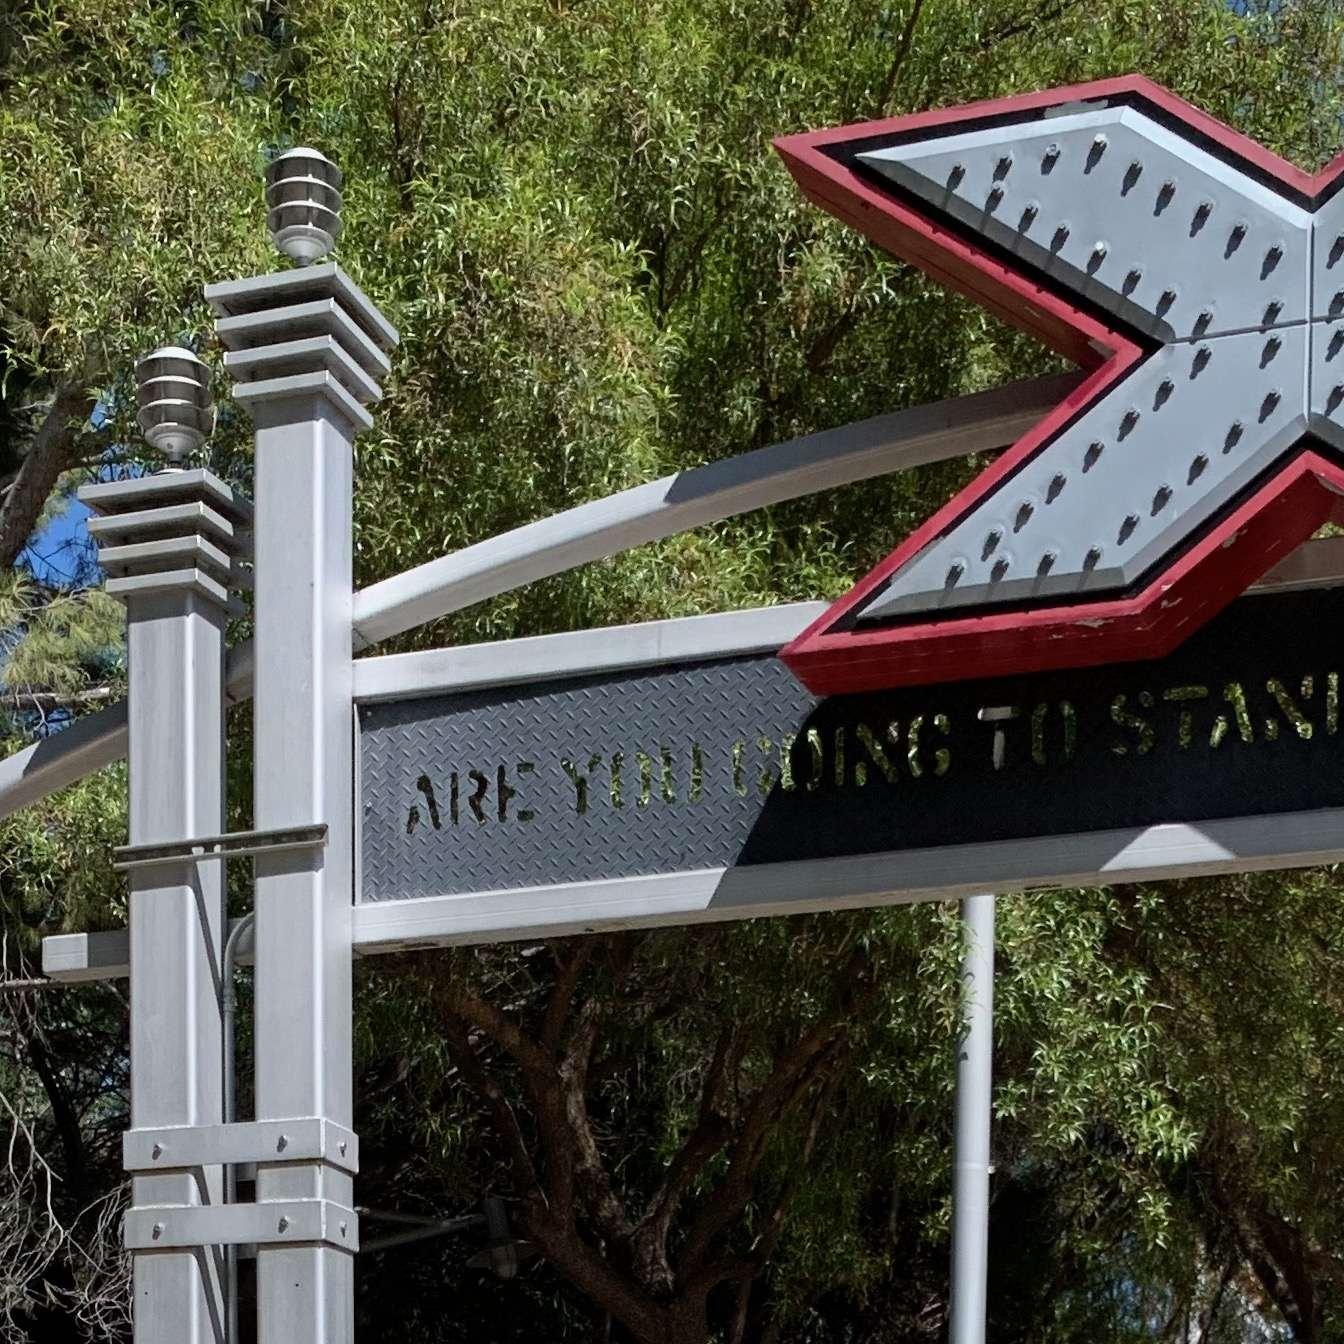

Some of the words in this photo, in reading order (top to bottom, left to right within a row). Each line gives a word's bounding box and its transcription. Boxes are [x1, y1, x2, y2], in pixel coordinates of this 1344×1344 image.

[406, 762, 536, 835] ARE
[559, 740, 703, 817] YOU
[731, 712, 951, 798] GOING
[976, 701, 1078, 771] TO
